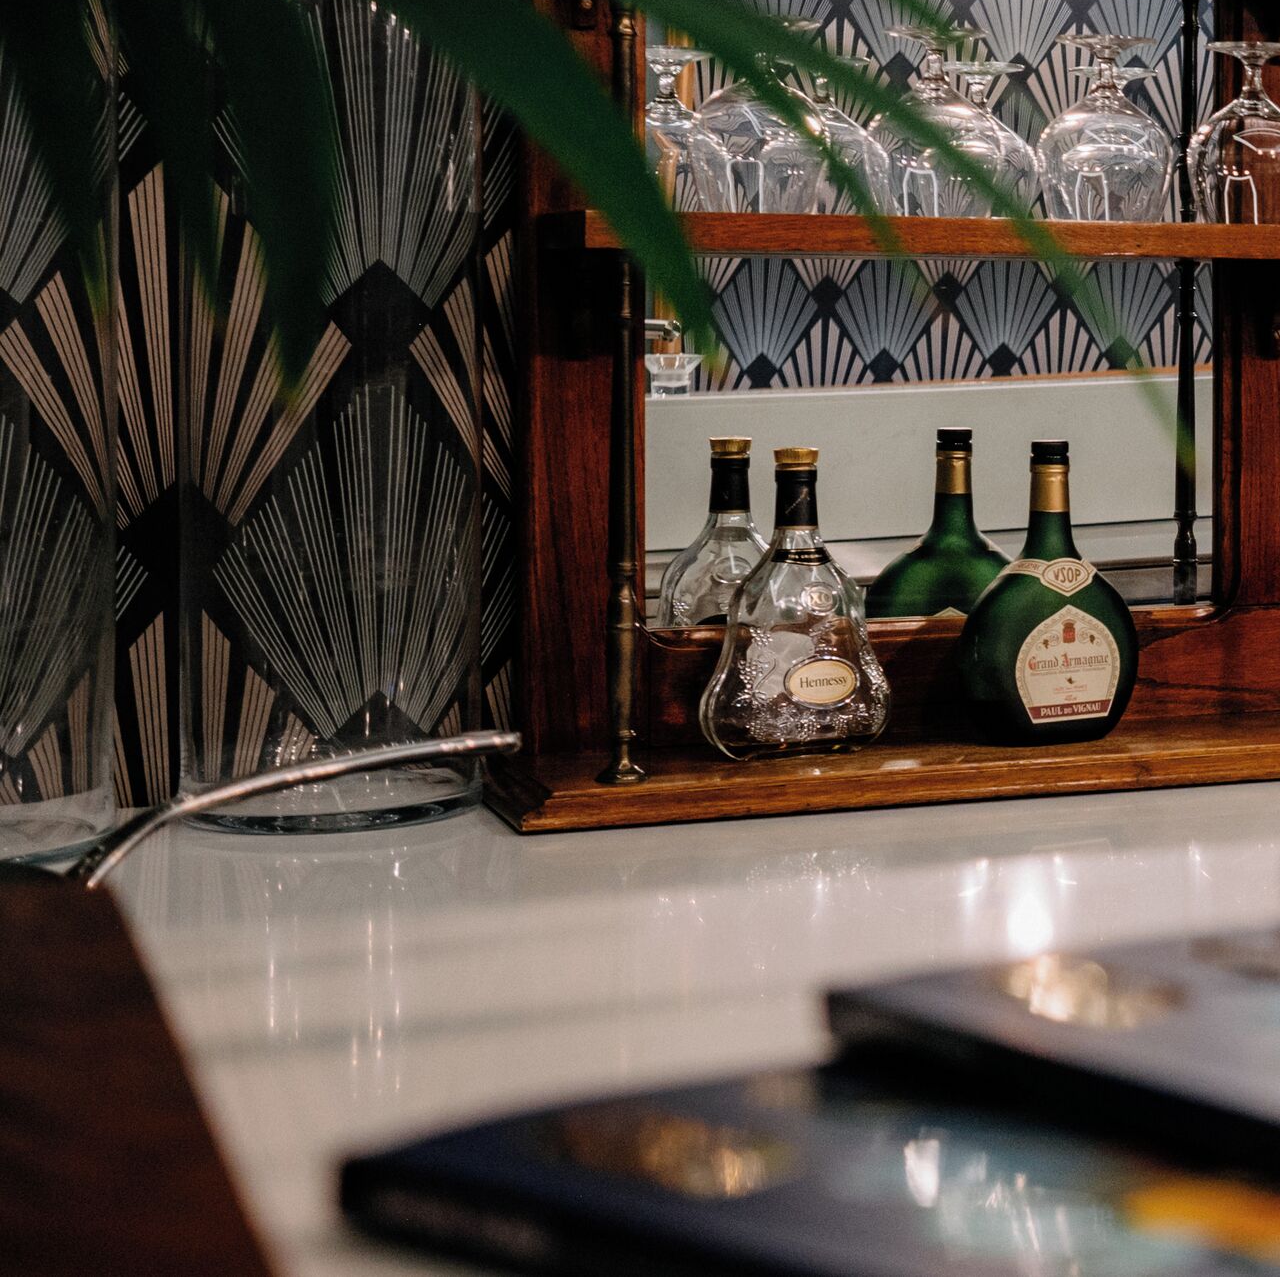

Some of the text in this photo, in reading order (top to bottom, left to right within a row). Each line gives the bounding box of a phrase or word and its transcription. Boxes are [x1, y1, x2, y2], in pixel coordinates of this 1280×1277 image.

[1053, 567, 1081, 583] VSOP
[1028, 656, 1059, 671] Grand
[1061, 653, 1109, 667] Armagnac
[800, 676, 848, 688] Hennessy
[1040, 707, 1062, 717] PAUL
[1072, 702, 1101, 713] VIGNAU
